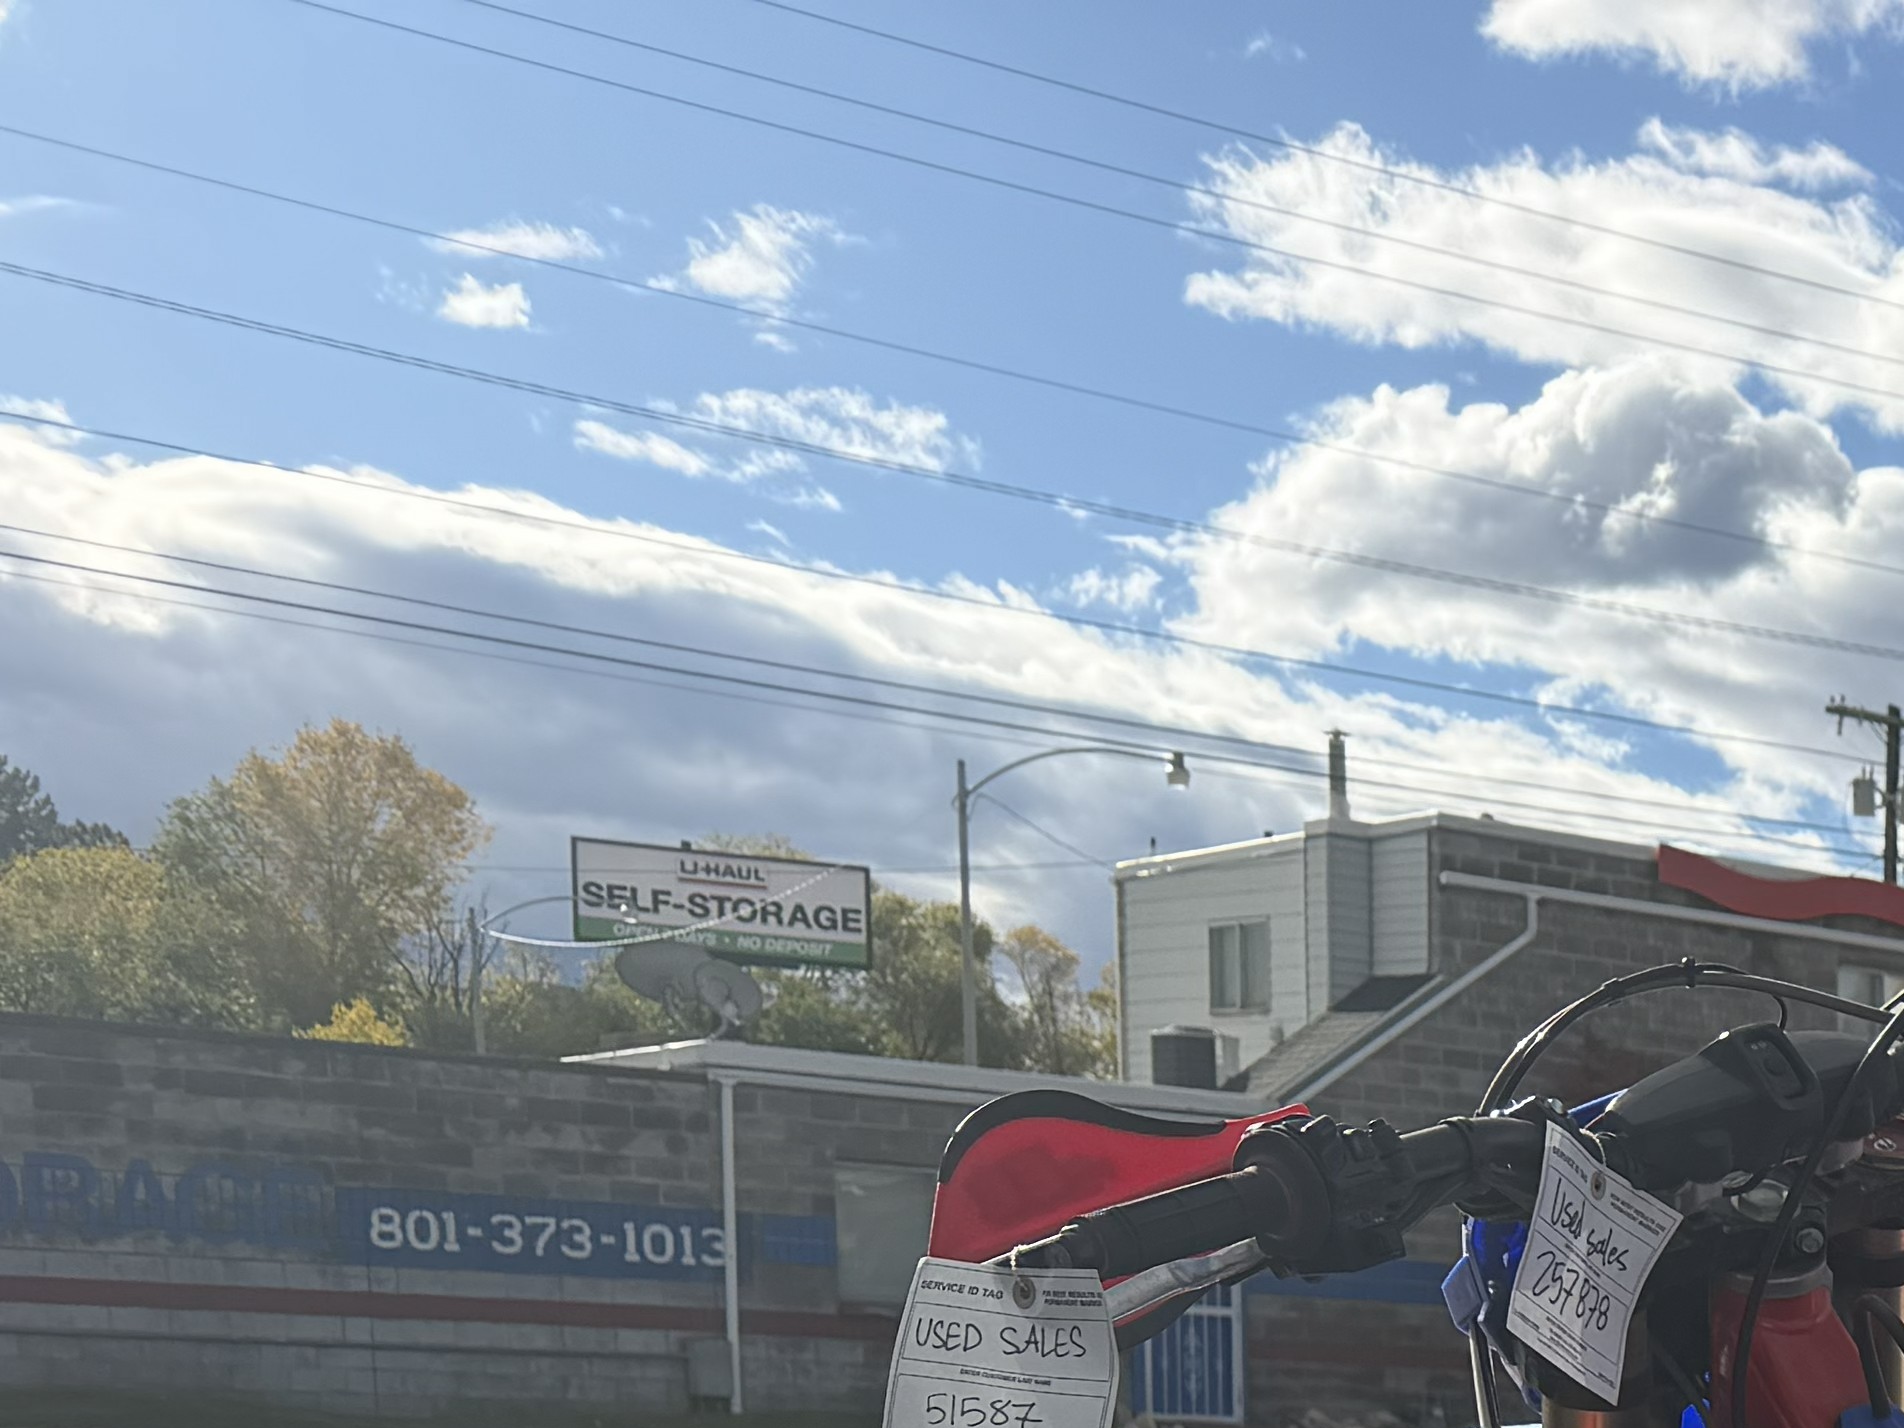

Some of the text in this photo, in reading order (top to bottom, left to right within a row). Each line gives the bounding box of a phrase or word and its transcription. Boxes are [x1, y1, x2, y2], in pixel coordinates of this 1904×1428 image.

[680, 859, 766, 882] U-HAUL
[582, 881, 863, 934] SELF-STORAGE
[736, 936, 761, 949] NO
[765, 939, 833, 956] DEPOSIT
[370, 1206, 725, 1267] 801-373-1013
[920, 1280, 1004, 1300] SERVICE ID TAG
[1532, 1250, 1610, 1331] 257878
[916, 1318, 1086, 1357] USED SALES
